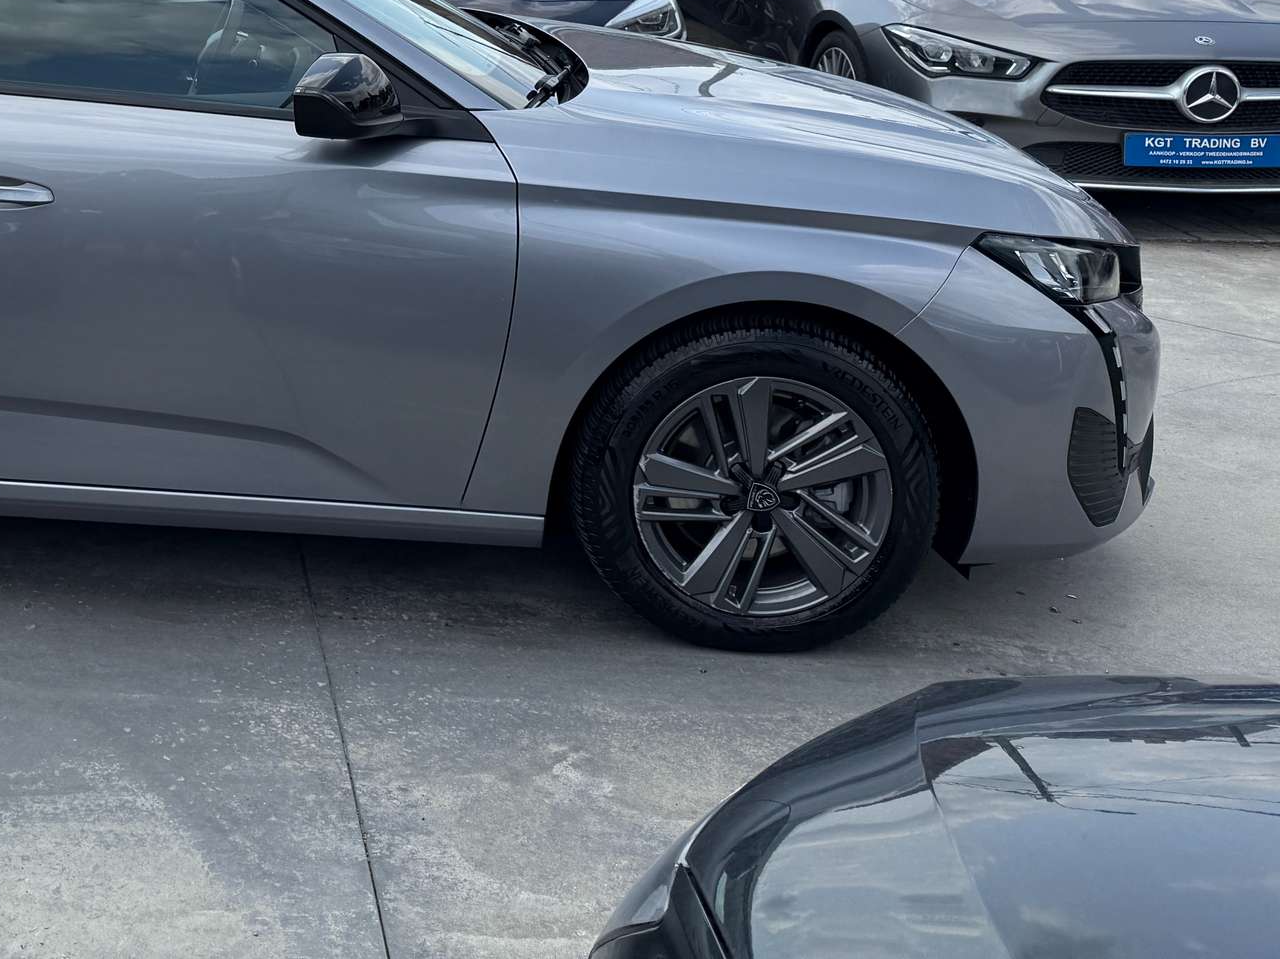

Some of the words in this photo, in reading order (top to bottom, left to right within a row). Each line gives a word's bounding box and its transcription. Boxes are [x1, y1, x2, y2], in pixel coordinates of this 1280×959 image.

[1144, 137, 1173, 148] KGT
[1183, 138, 1241, 149] TRADING
[1250, 138, 1268, 148] BV
